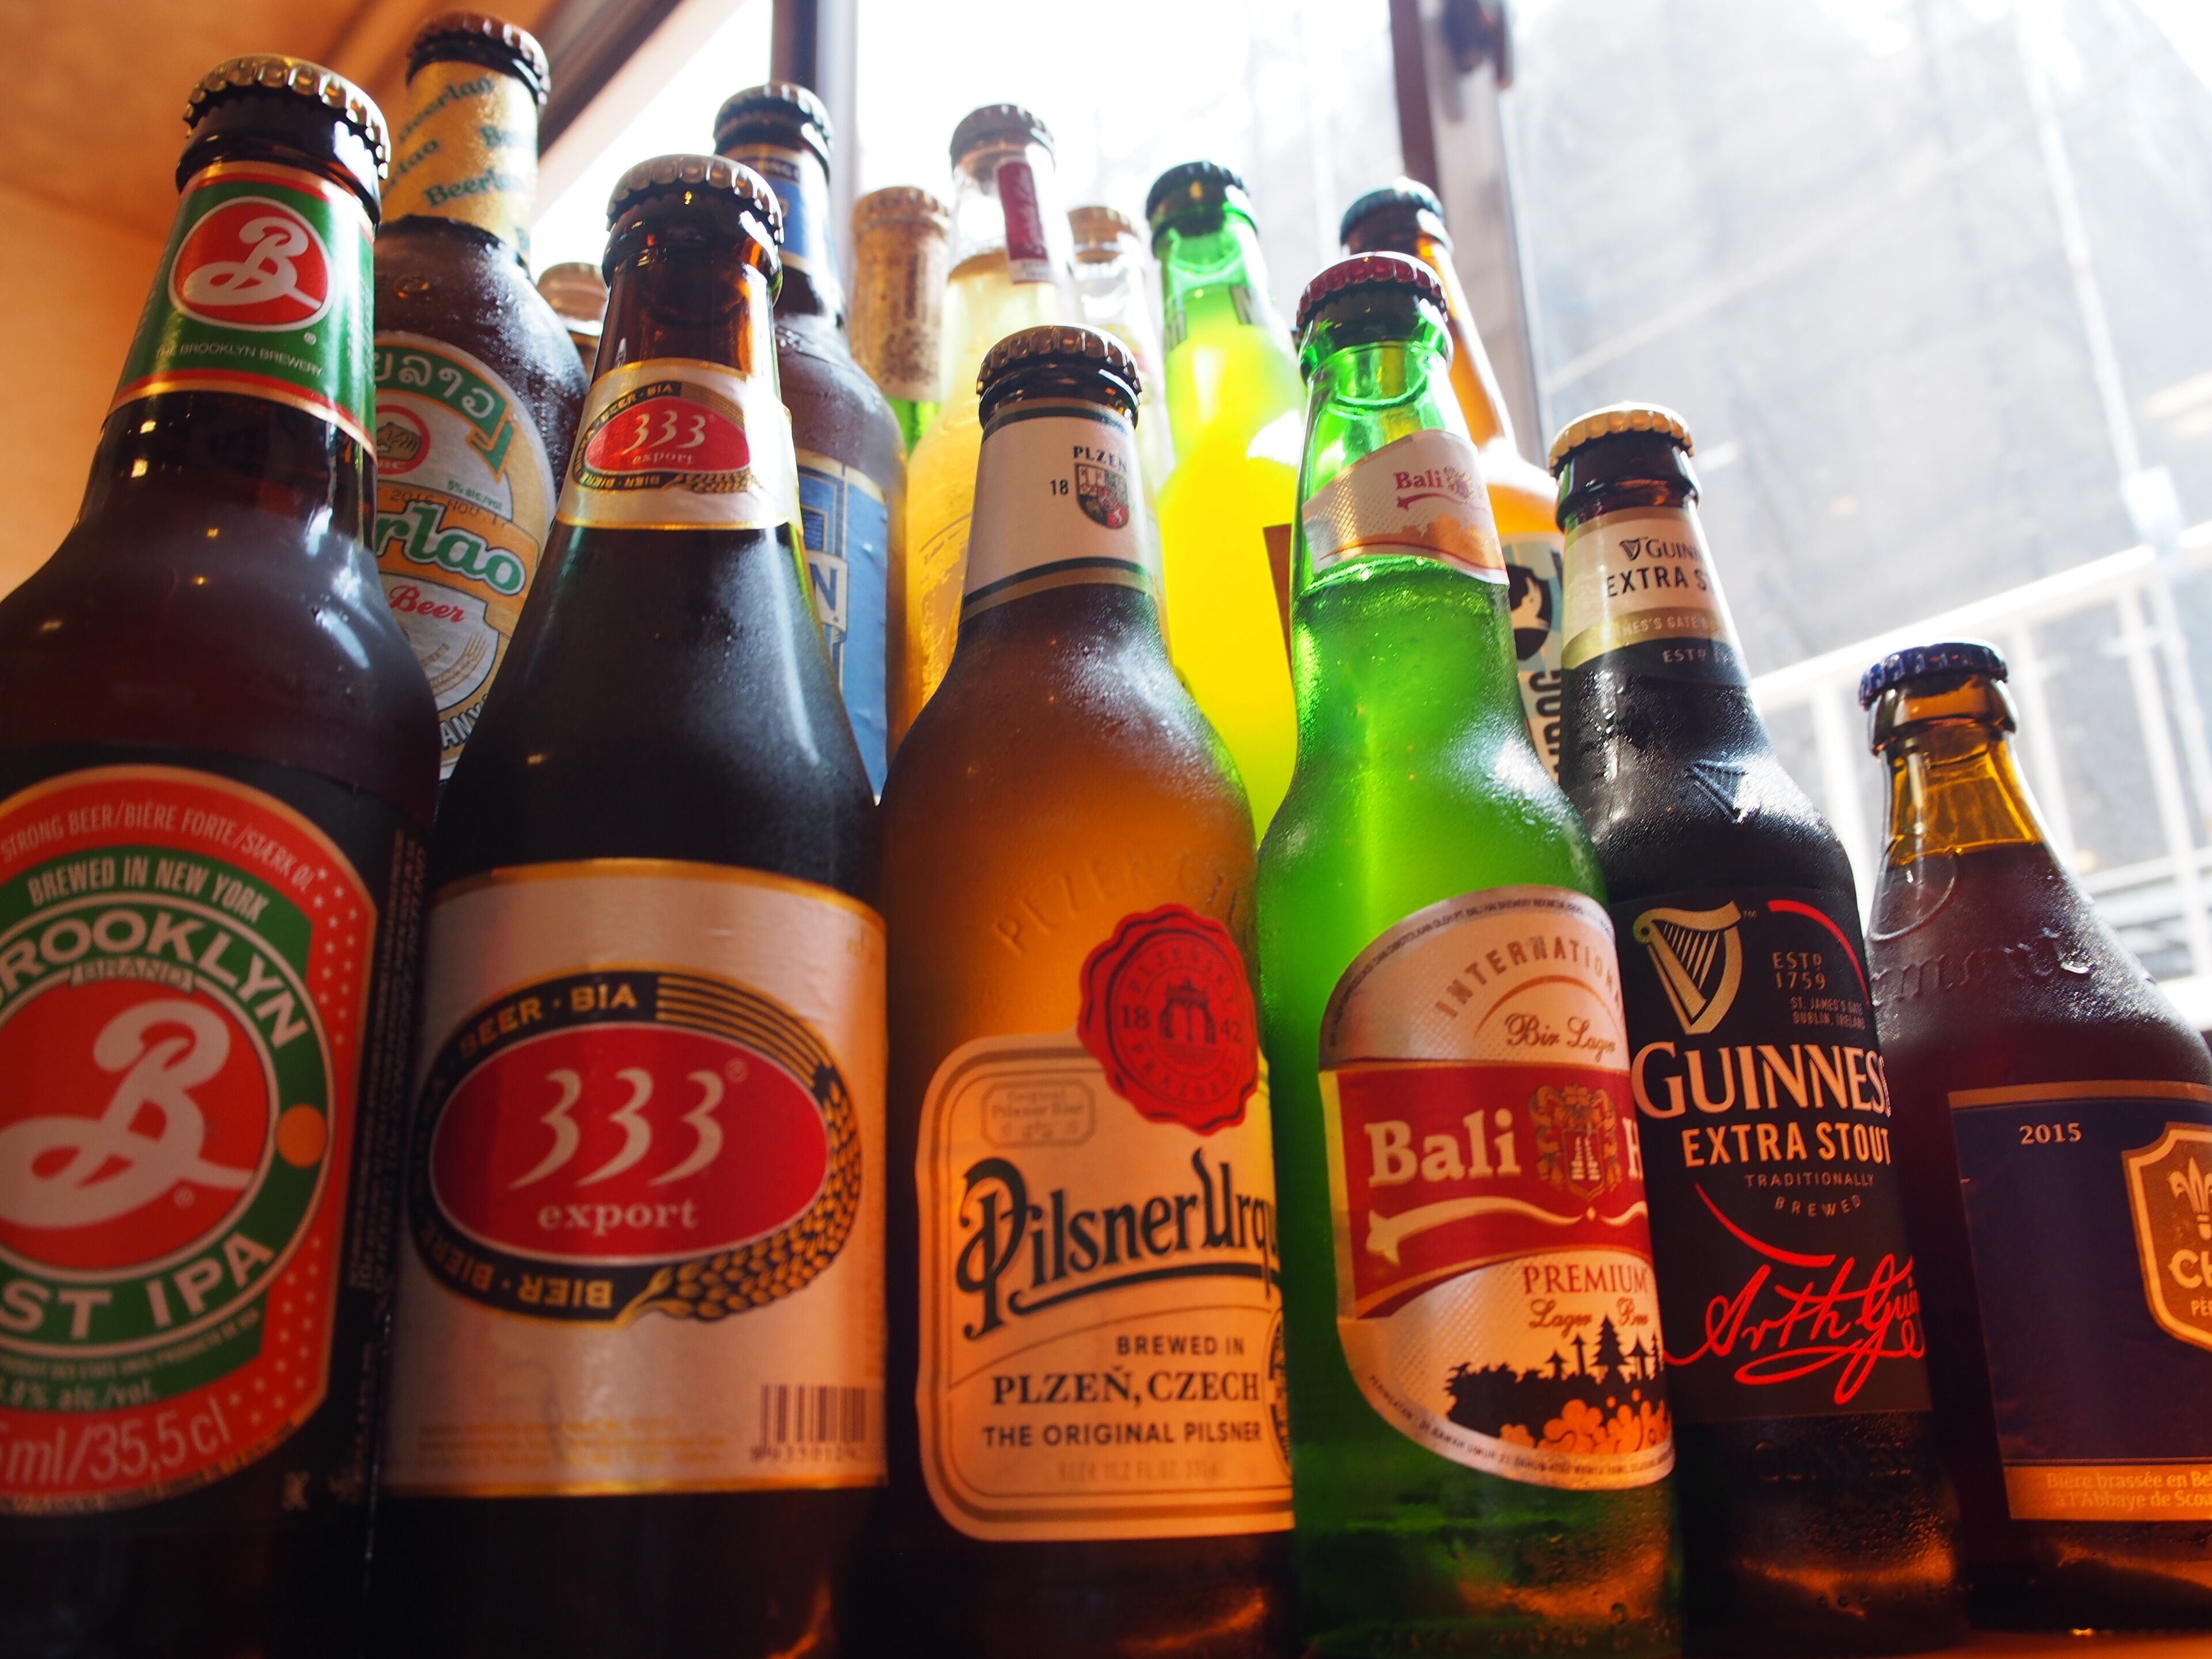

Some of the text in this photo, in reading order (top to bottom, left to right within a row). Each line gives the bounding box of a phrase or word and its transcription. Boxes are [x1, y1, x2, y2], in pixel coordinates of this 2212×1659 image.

[180, 343, 256, 357] BROOKLYN
[259, 348, 323, 377] BREWERY
[621, 409, 706, 456] 333
[632, 450, 695, 466] export
[1049, 479, 1070, 496] 18
[1392, 469, 1444, 490] Bali
[1606, 566, 1689, 598] EXTRA
[389, 585, 464, 622] Beer
[1667, 616, 1696, 630] GATE
[28, 855, 270, 923] BREWED IN NEW YORK
[0, 908, 309, 1049] ROOKLYN
[1775, 971, 1827, 990] 1759
[460, 982, 638, 1058] BEER BIA
[1122, 1005, 1150, 1031] 18
[1792, 1012, 1834, 1027] DUBLIN,
[1810, 997, 1847, 1013] JAMES'S
[507, 1066, 725, 1191] 333
[1681, 1120, 1892, 1168] EXTRA STOUT
[2018, 1122, 2083, 1146] 2015
[1364, 1107, 1522, 1190] Bali
[1743, 1171, 1874, 1189] TRADITIONALLY
[538, 1196, 699, 1238] export
[1774, 1194, 1862, 1218] BREWED
[956, 1157, 1198, 1341] Pilsner
[145, 1231, 275, 1329] IPA
[517, 1273, 613, 1310] BIER
[1522, 1263, 1649, 1296] PREMIUM
[1528, 1298, 1593, 1340] Lager
[1117, 1335, 1245, 1357] BREWED IN
[991, 1364, 1260, 1409] PLZEŇ, CZECH
[983, 1421, 1262, 1447] THE ORIGINAL PILSNER
[2096, 1470, 2164, 1488] brassée
[2166, 1474, 2188, 1488] en
[2149, 1490, 2171, 1507] de
